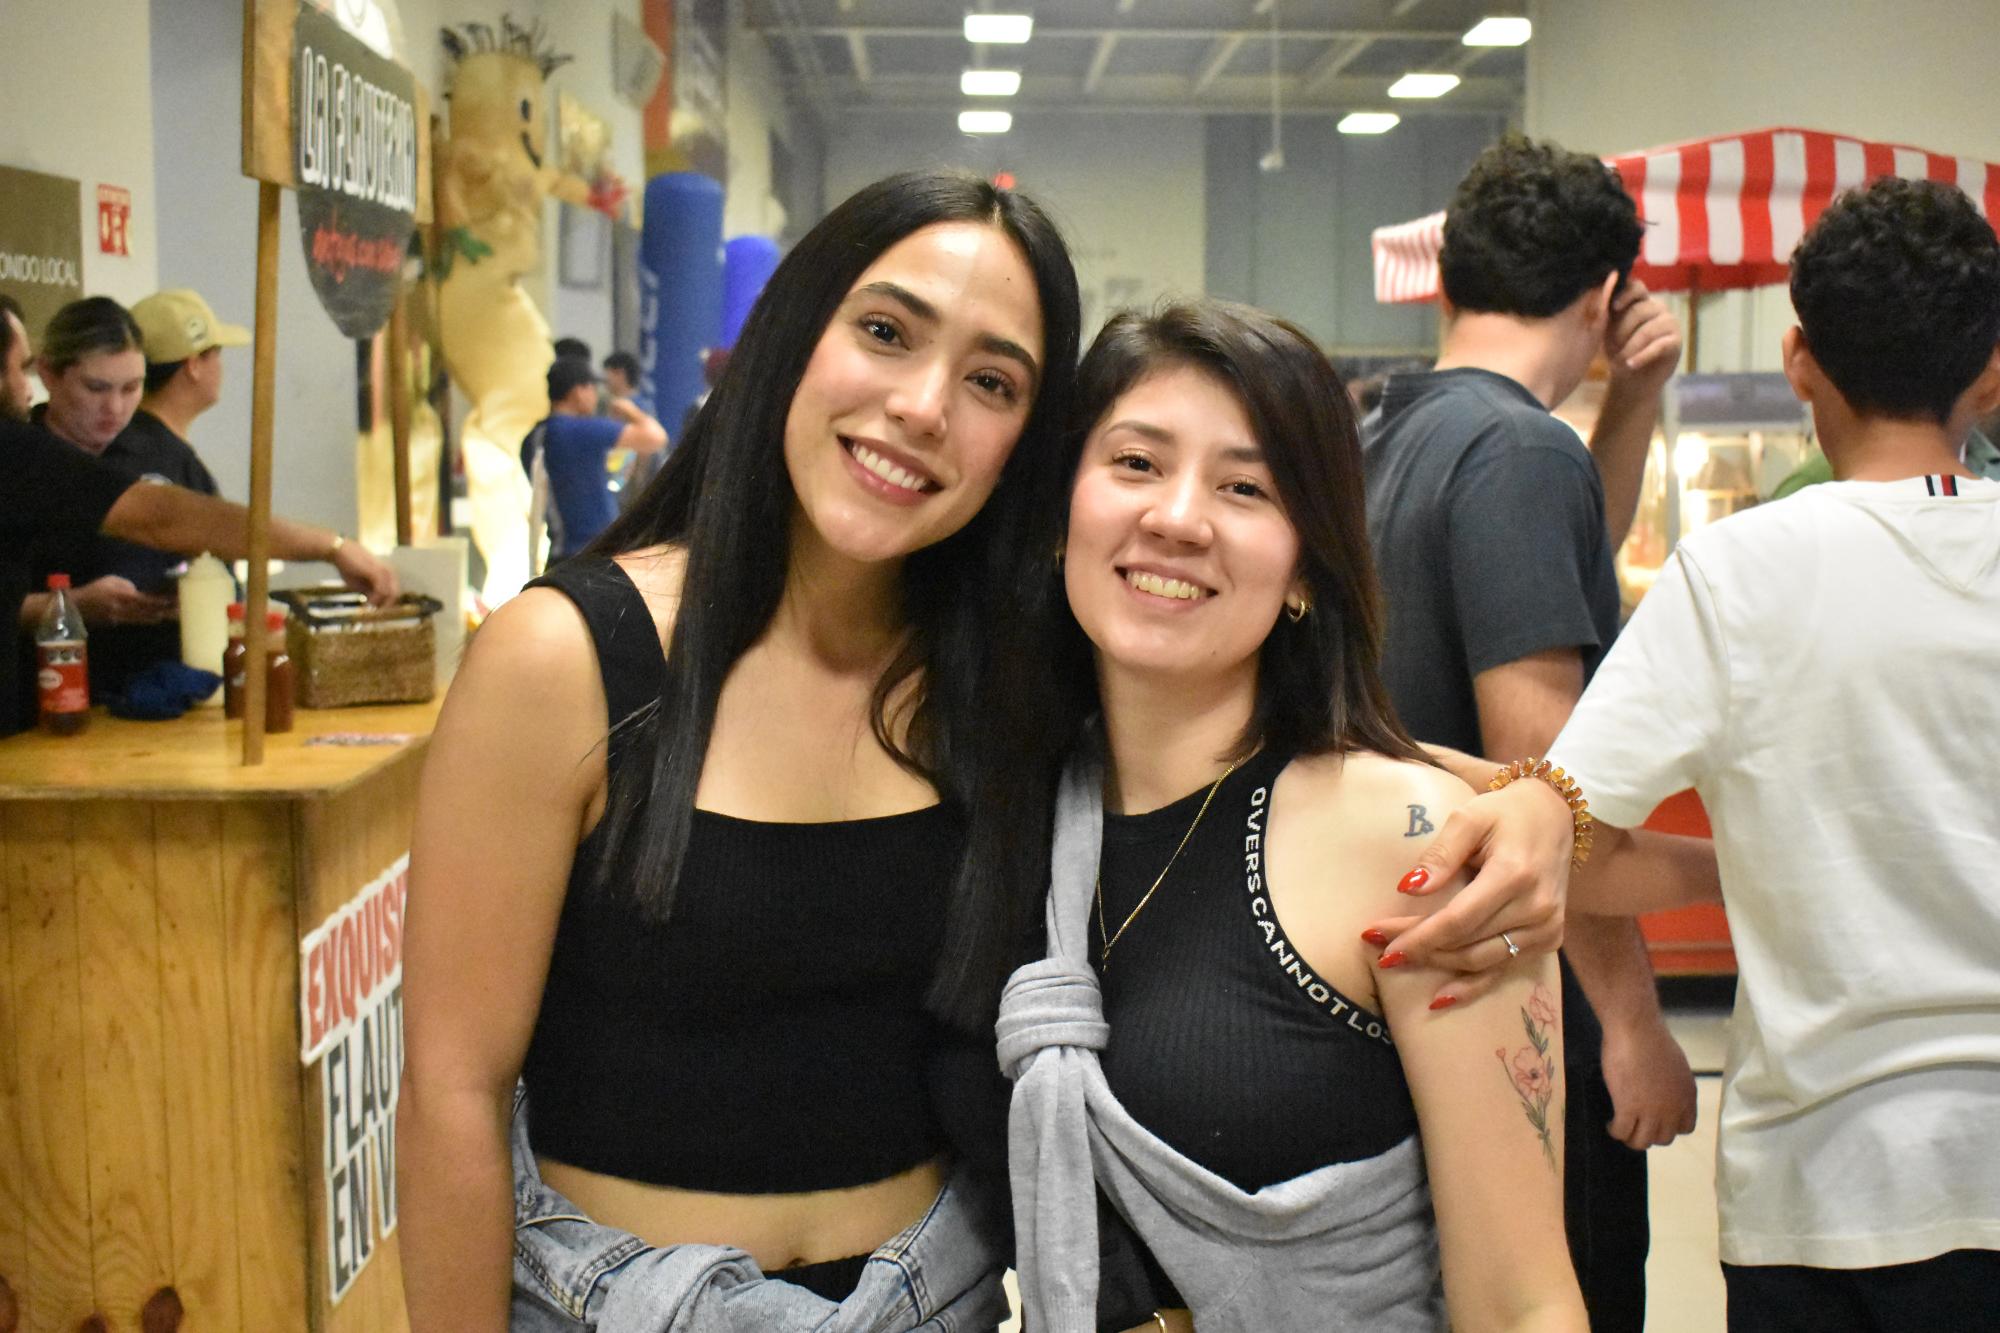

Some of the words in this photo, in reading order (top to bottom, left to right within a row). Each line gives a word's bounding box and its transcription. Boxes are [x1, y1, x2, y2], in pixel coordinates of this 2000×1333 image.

[302, 46, 329, 190] LA
[1404, 804, 1434, 837] B
[332, 1142, 371, 1295] EN
